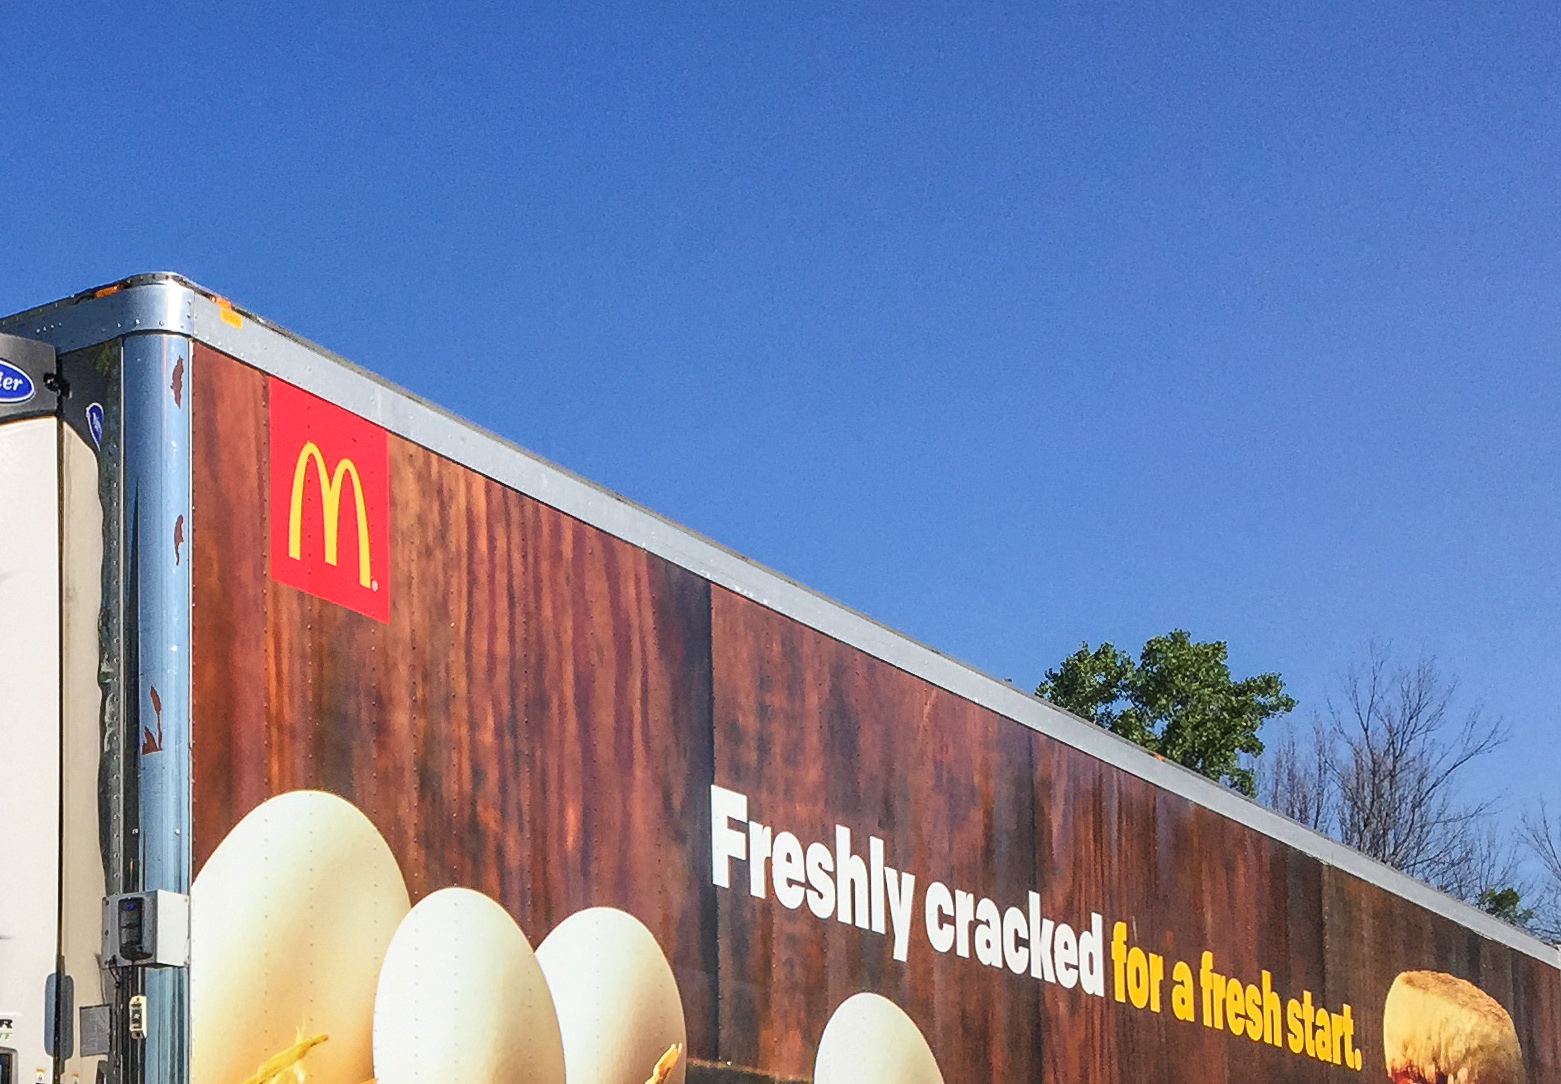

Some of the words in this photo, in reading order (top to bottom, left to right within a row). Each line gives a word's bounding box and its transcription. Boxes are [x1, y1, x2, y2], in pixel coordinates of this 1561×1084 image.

[710, 783, 915, 963] Freshly
[925, 881, 1105, 998] cracked
[1111, 921, 1164, 1013] for
[1171, 961, 1195, 1022] a
[1199, 950, 1283, 1048] fresh
[1286, 989, 1363, 1072] start.
